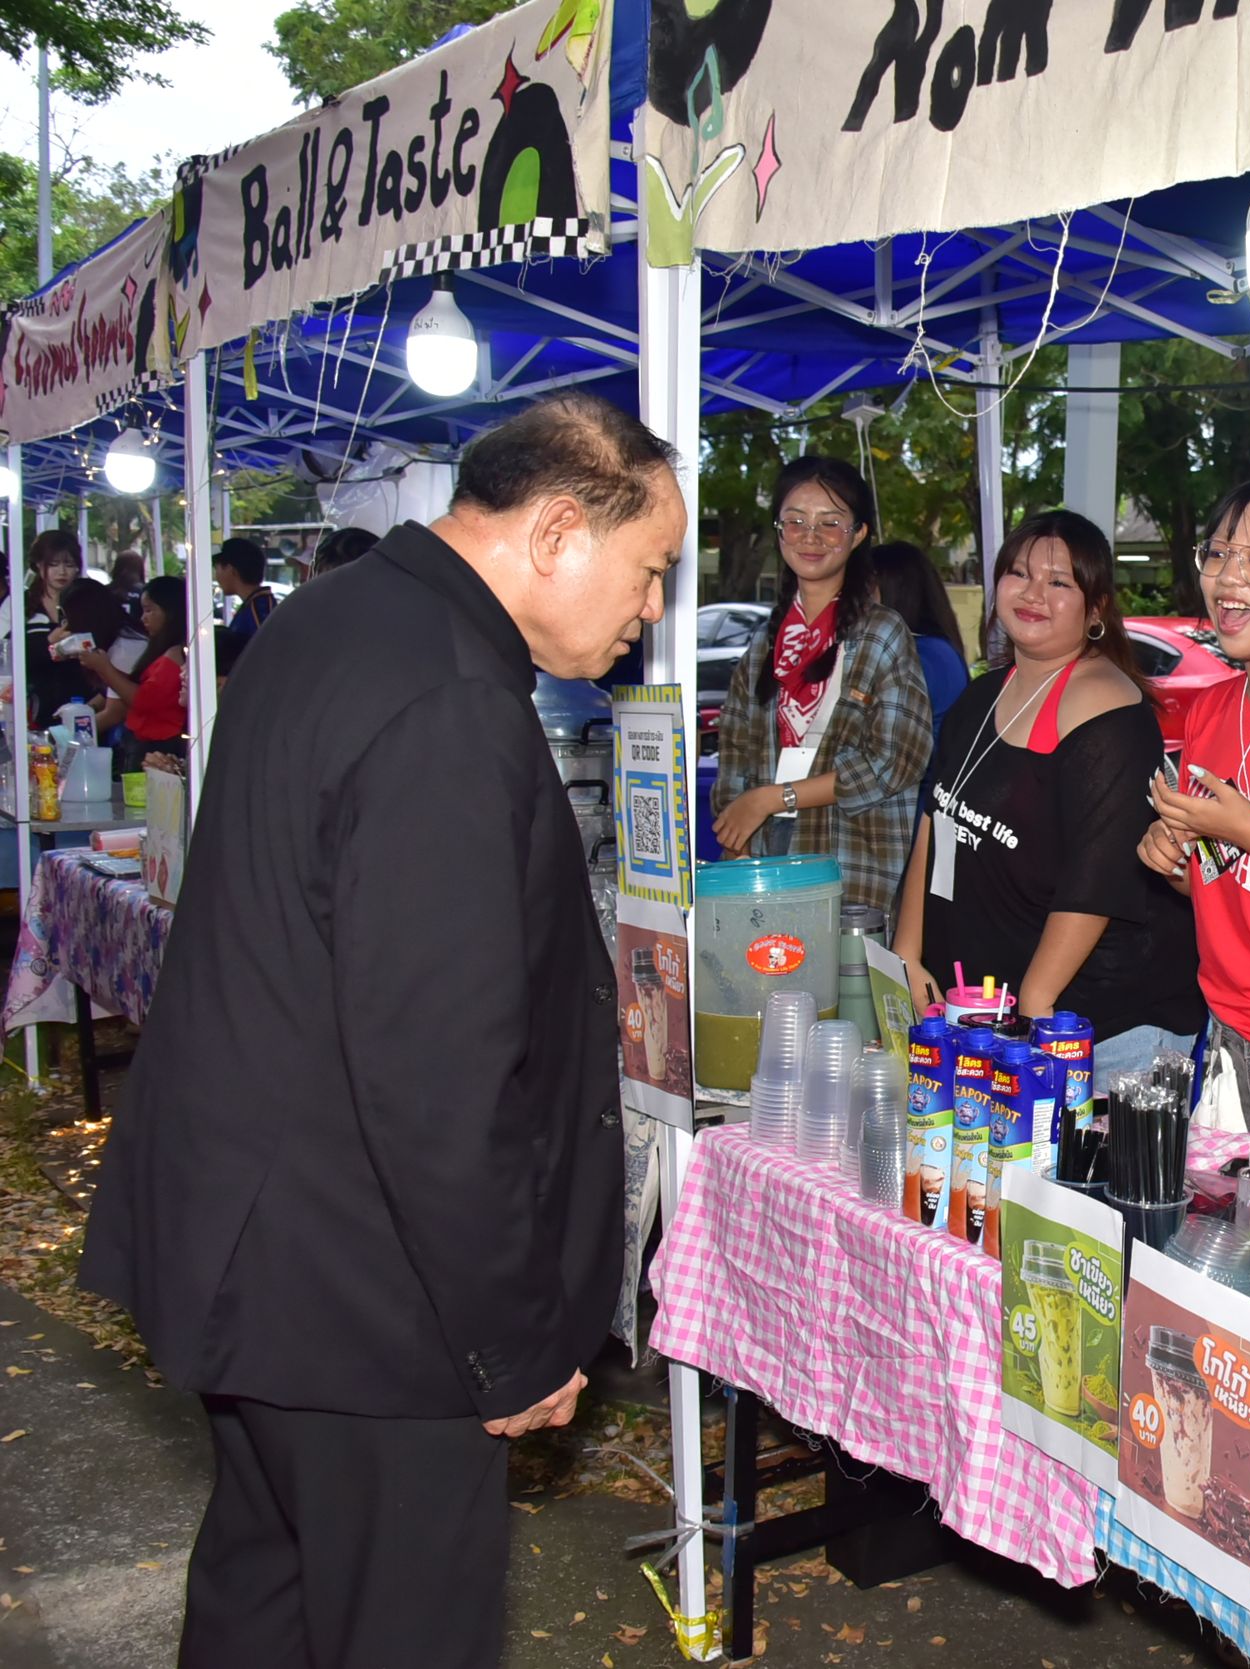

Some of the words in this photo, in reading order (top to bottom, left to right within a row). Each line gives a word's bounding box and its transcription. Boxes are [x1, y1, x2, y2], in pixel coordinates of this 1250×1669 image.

[241, 126, 321, 290] Ball
[320, 127, 354, 243] &
[358, 69, 480, 226] Taste
[641, 745, 660, 762] CODE
[958, 800, 992, 832] best
[992, 821, 1019, 849] life
[627, 1008, 643, 1030] 40
[909, 1072, 942, 1093] EAPOT
[955, 1085, 991, 1106] EAPOT
[990, 1101, 1021, 1124] EAPOT
[1070, 1248, 1113, 1296] ชาเขียว
[1079, 1278, 1116, 1319] เหนียว
[1012, 1311, 1037, 1341] 45
[1021, 1340, 1036, 1353] บาท
[1131, 1399, 1160, 1432] 40
[1138, 1429, 1157, 1445] บาท
